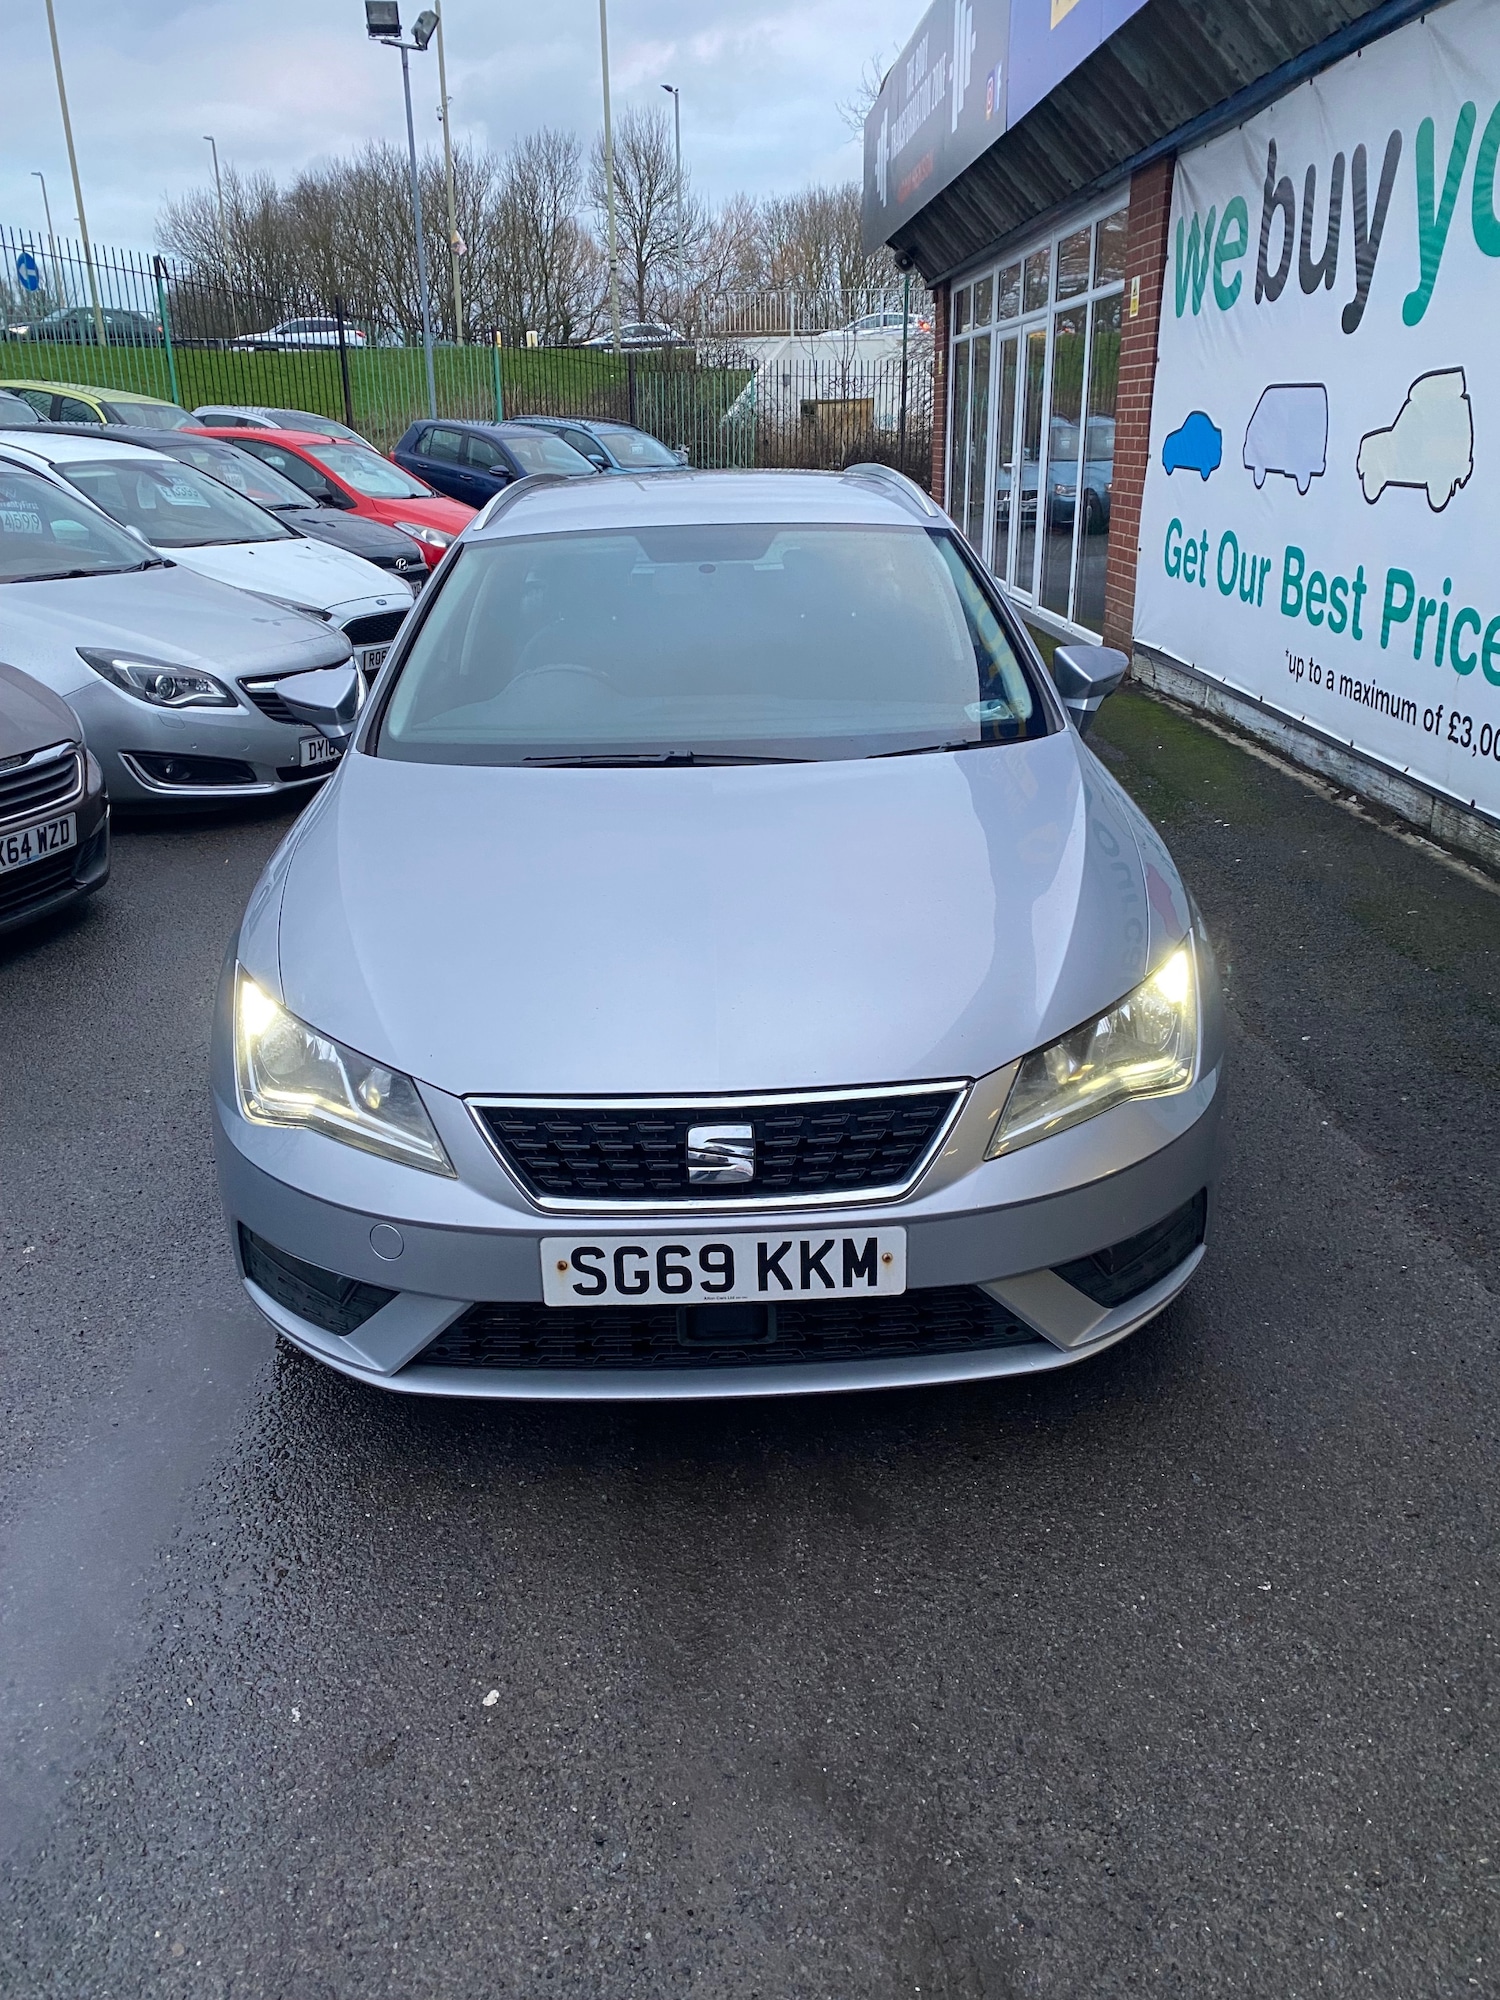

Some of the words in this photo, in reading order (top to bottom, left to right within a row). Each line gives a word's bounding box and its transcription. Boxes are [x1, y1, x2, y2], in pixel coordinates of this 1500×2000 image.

[5, 513, 39, 530] 4599
[1164, 517, 1209, 588] Get
[1217, 530, 1271, 607] Our
[1280, 545, 1367, 641] Best
[1308, 657, 1322, 685] to
[1326, 670, 1335, 691] a
[1339, 679, 1417, 725] maximum
[1423, 704, 1444, 735] of
[37, 819, 70, 854] WZD
[570, 1243, 735, 1296] SG69
[757, 1237, 878, 1291] KKM
